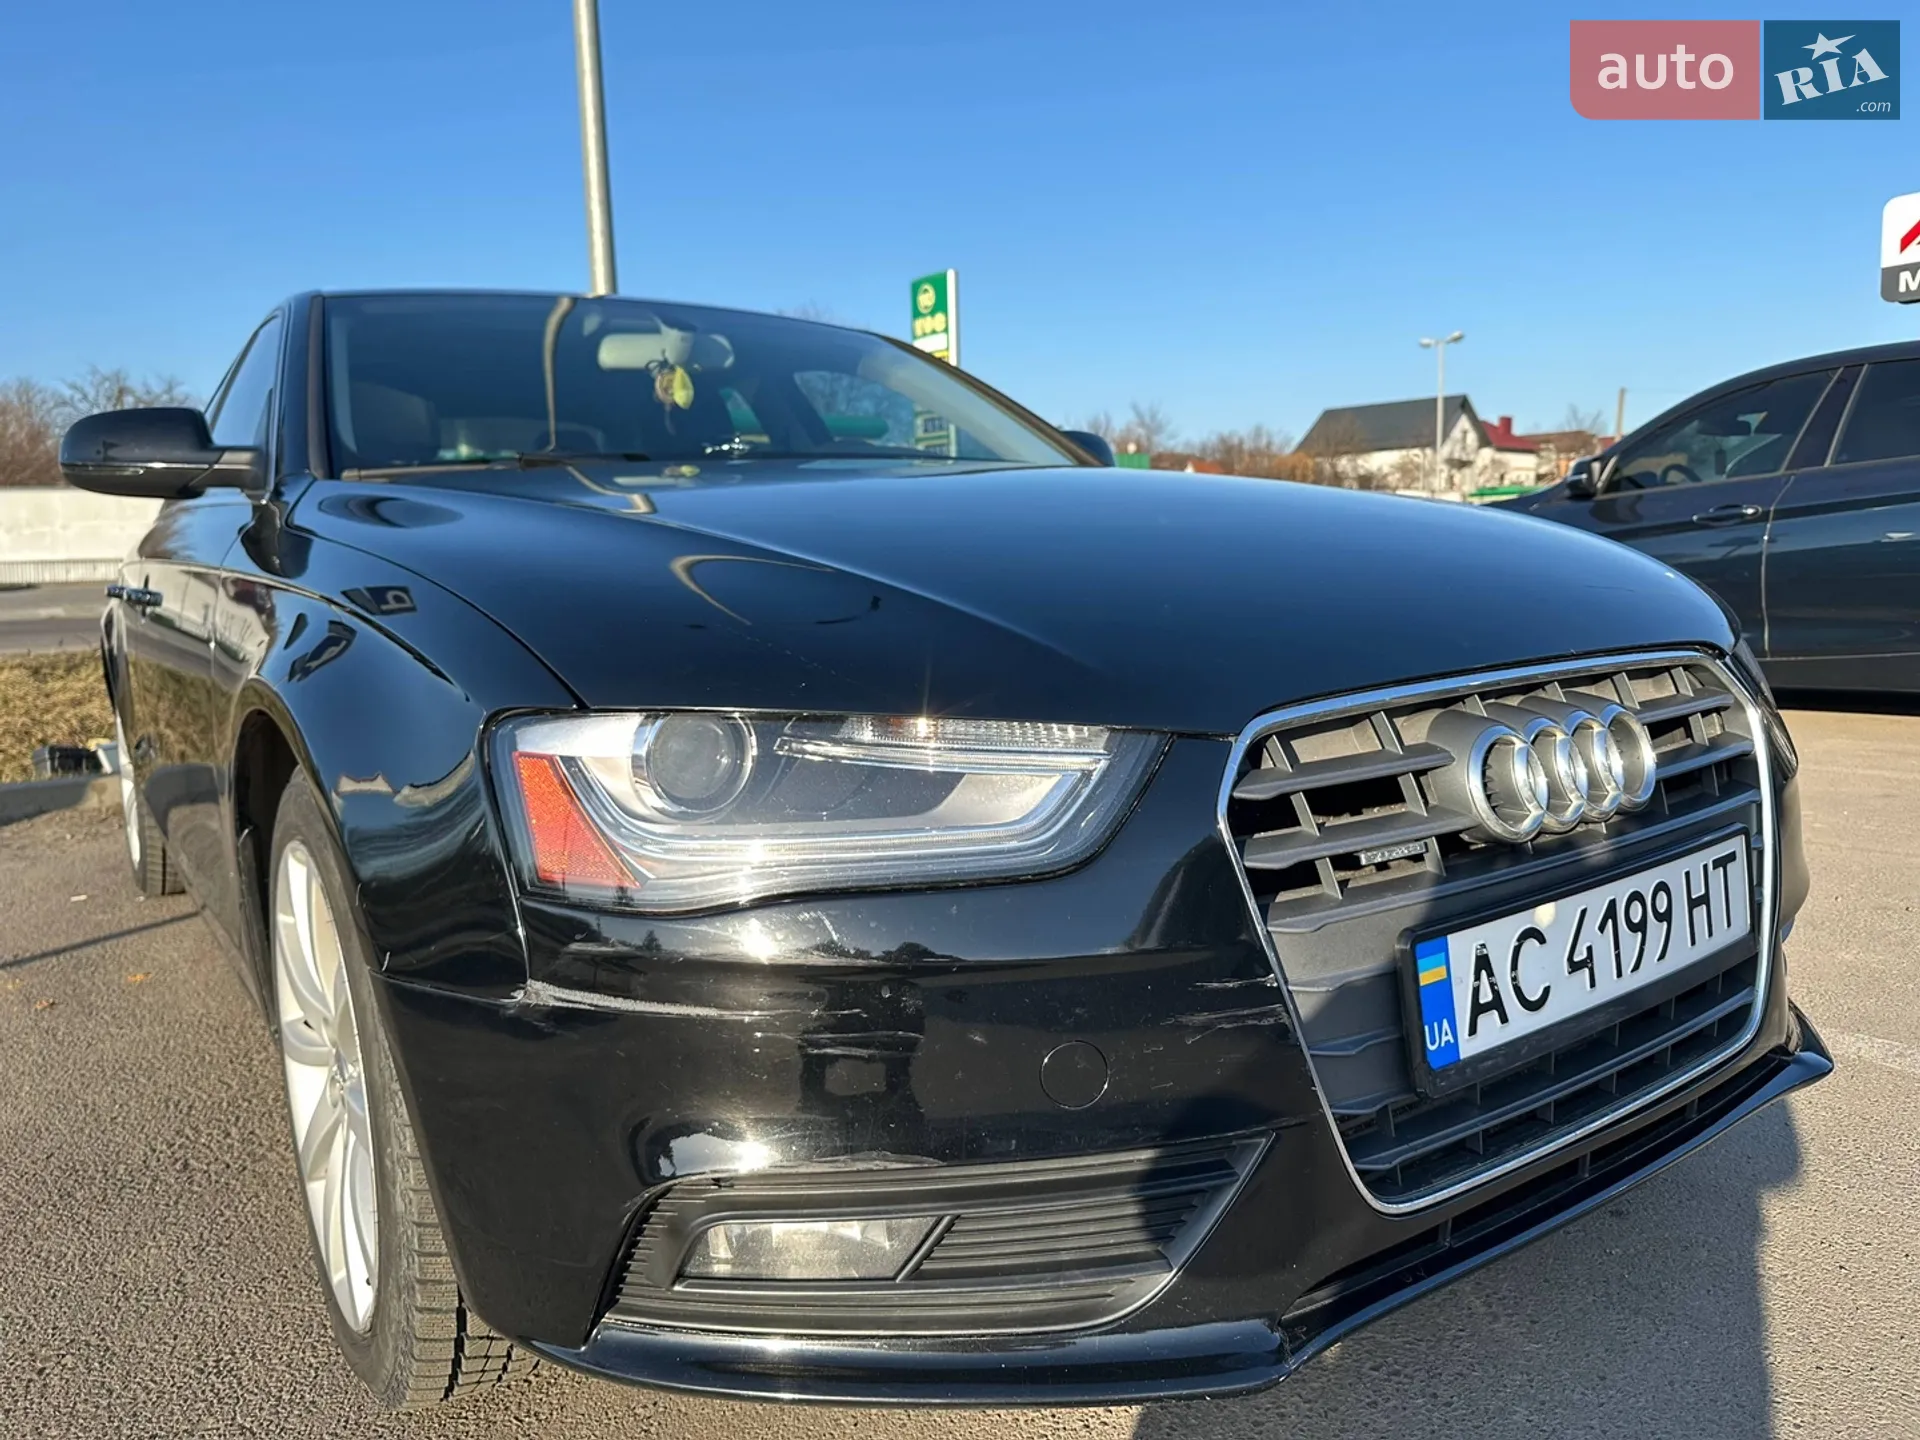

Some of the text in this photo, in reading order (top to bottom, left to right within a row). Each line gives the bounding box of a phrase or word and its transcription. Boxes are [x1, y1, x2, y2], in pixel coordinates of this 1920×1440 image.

[1464, 850, 1737, 1038] AC 4199 HT
[1424, 1019, 1454, 1051] UA
